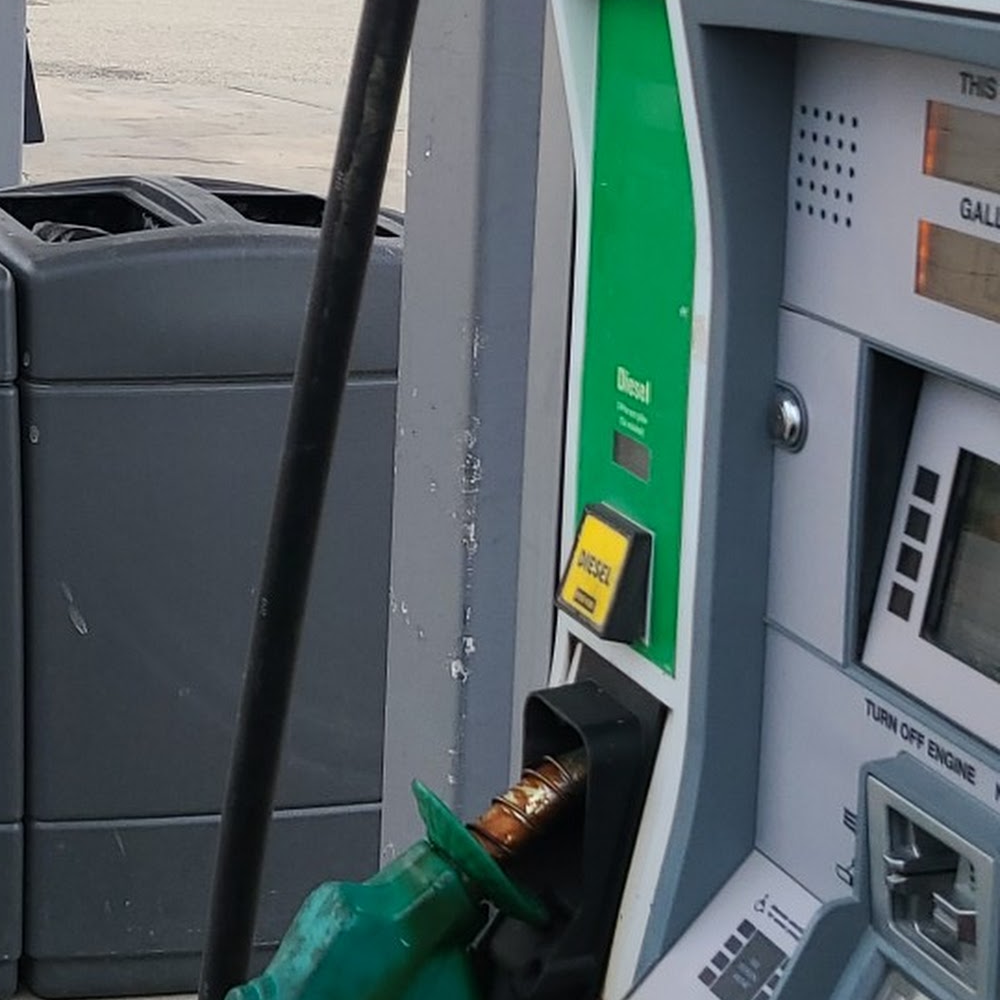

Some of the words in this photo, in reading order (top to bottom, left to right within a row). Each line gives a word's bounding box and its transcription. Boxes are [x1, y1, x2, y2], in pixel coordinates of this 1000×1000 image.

[959, 71, 998, 100] THIS
[617, 365, 650, 406] Diesel
[578, 549, 611, 587] DIESEL
[864, 697, 898, 736] TURN
[900, 722, 925, 750] OFF
[927, 739, 976, 787] ENGINE
